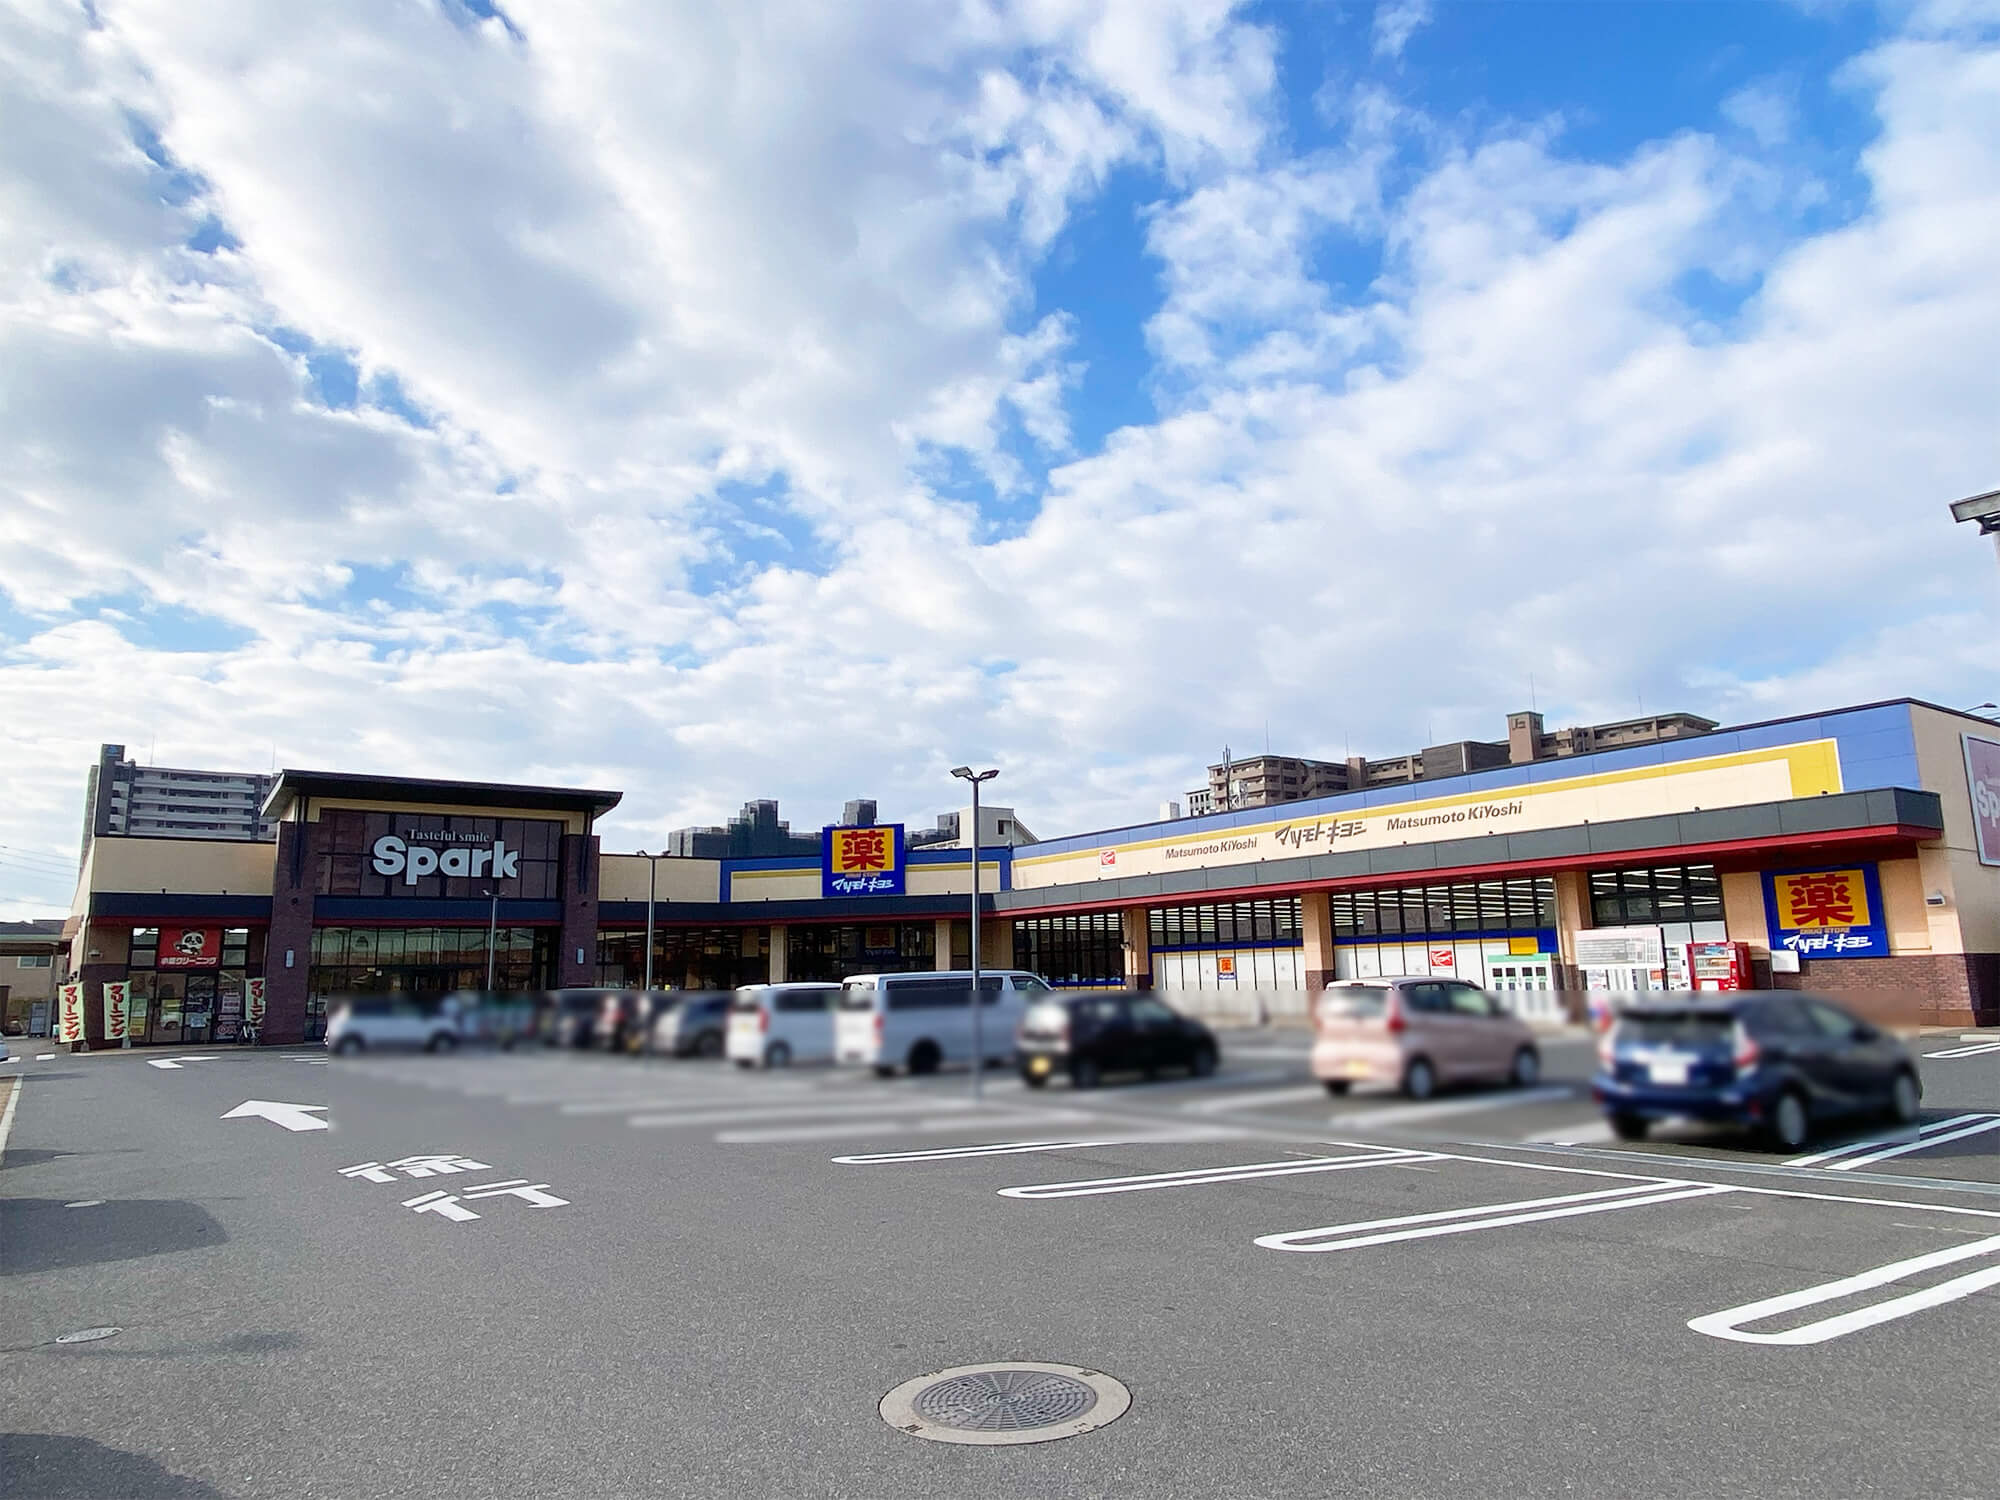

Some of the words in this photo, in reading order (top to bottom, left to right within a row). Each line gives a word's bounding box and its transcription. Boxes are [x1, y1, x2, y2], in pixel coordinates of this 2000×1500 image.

[1386, 812, 1466, 831] Matsumoto
[1467, 800, 1523, 821] KiYoshi
[409, 829, 456, 841] Tasteful
[459, 833, 490, 843] smile
[841, 830, 885, 870] 薬
[1165, 844, 1219, 859] Matsumoto
[1220, 837, 1258, 854] KiYoshi
[1275, 818, 1367, 849] マツモトキヨシ
[372, 835, 519, 886] Spark
[1787, 873, 1855, 926] 薬
[336, 1154, 571, 1222] 徐行
